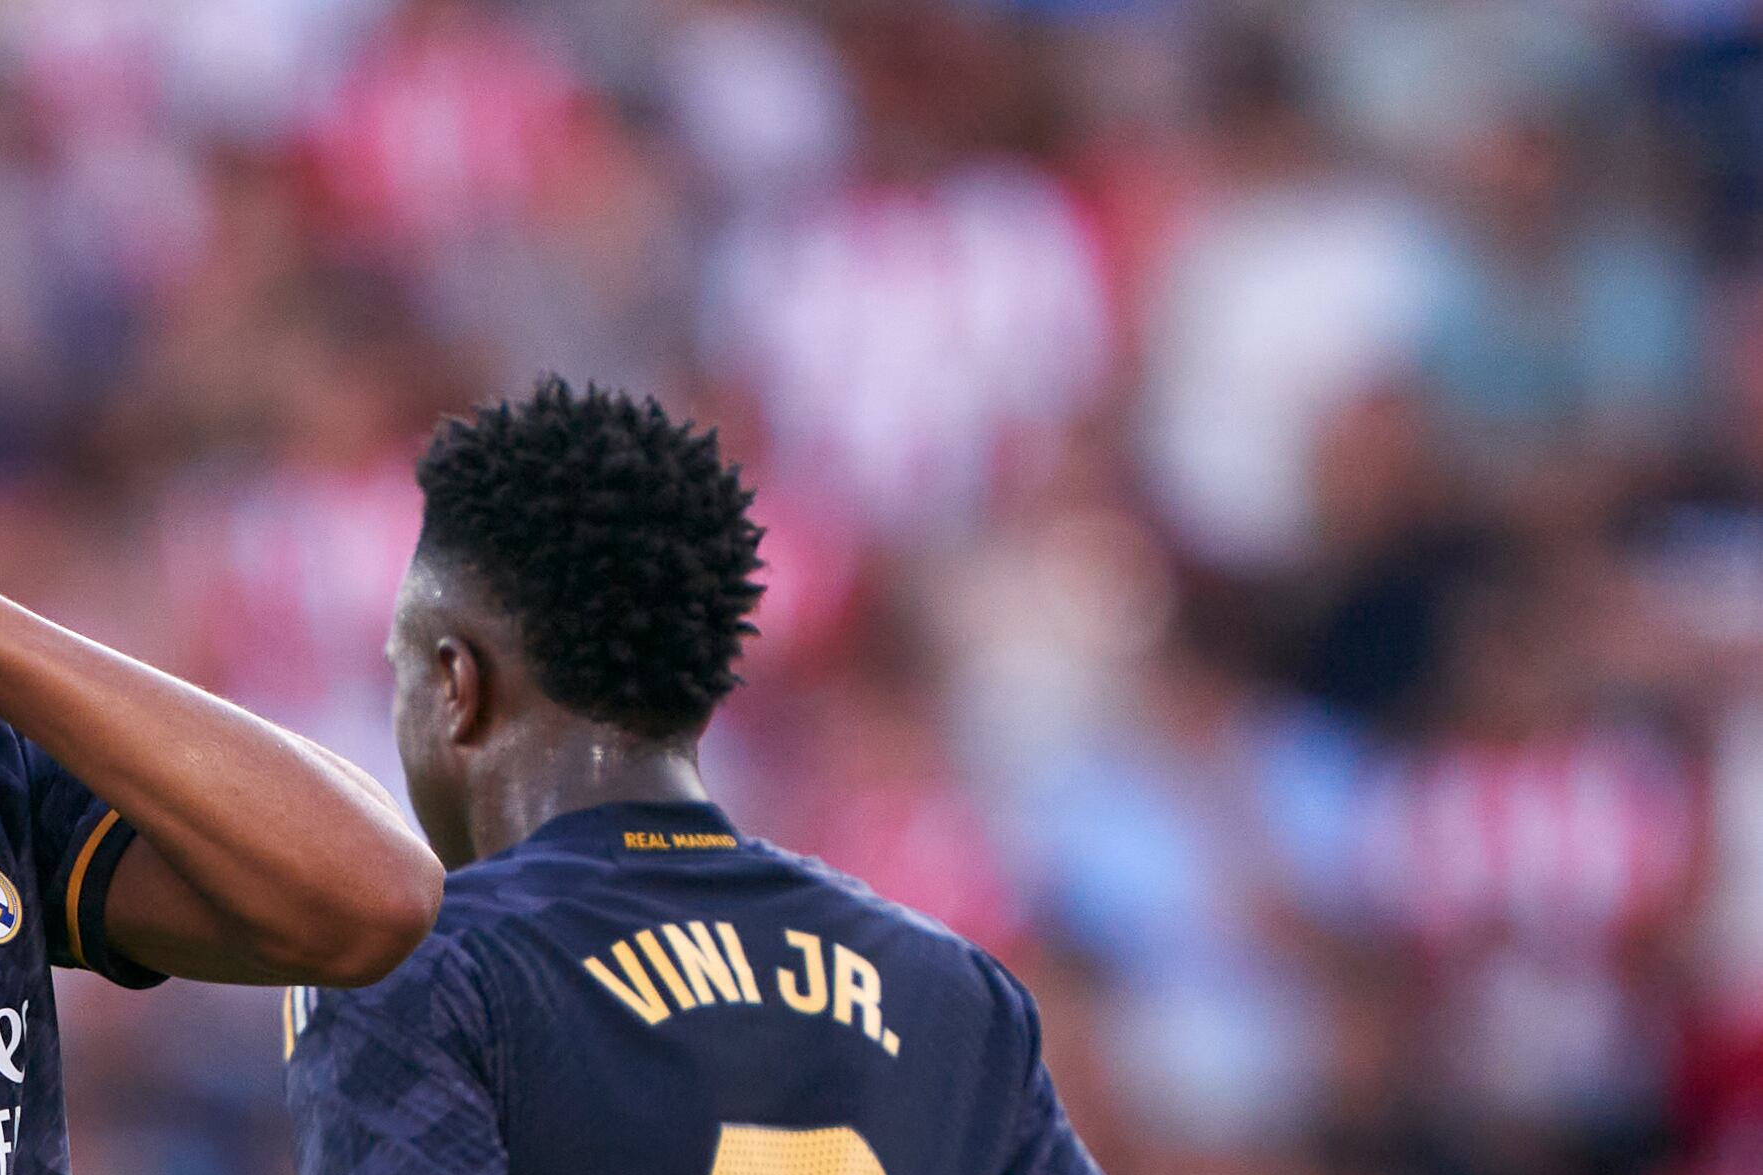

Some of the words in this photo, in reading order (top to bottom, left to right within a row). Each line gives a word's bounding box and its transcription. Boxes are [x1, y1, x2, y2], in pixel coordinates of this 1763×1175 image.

[624, 832, 670, 848] REAL
[672, 832, 737, 849] MADRID
[583, 920, 762, 1025] VINI
[777, 928, 900, 1057] JR.
